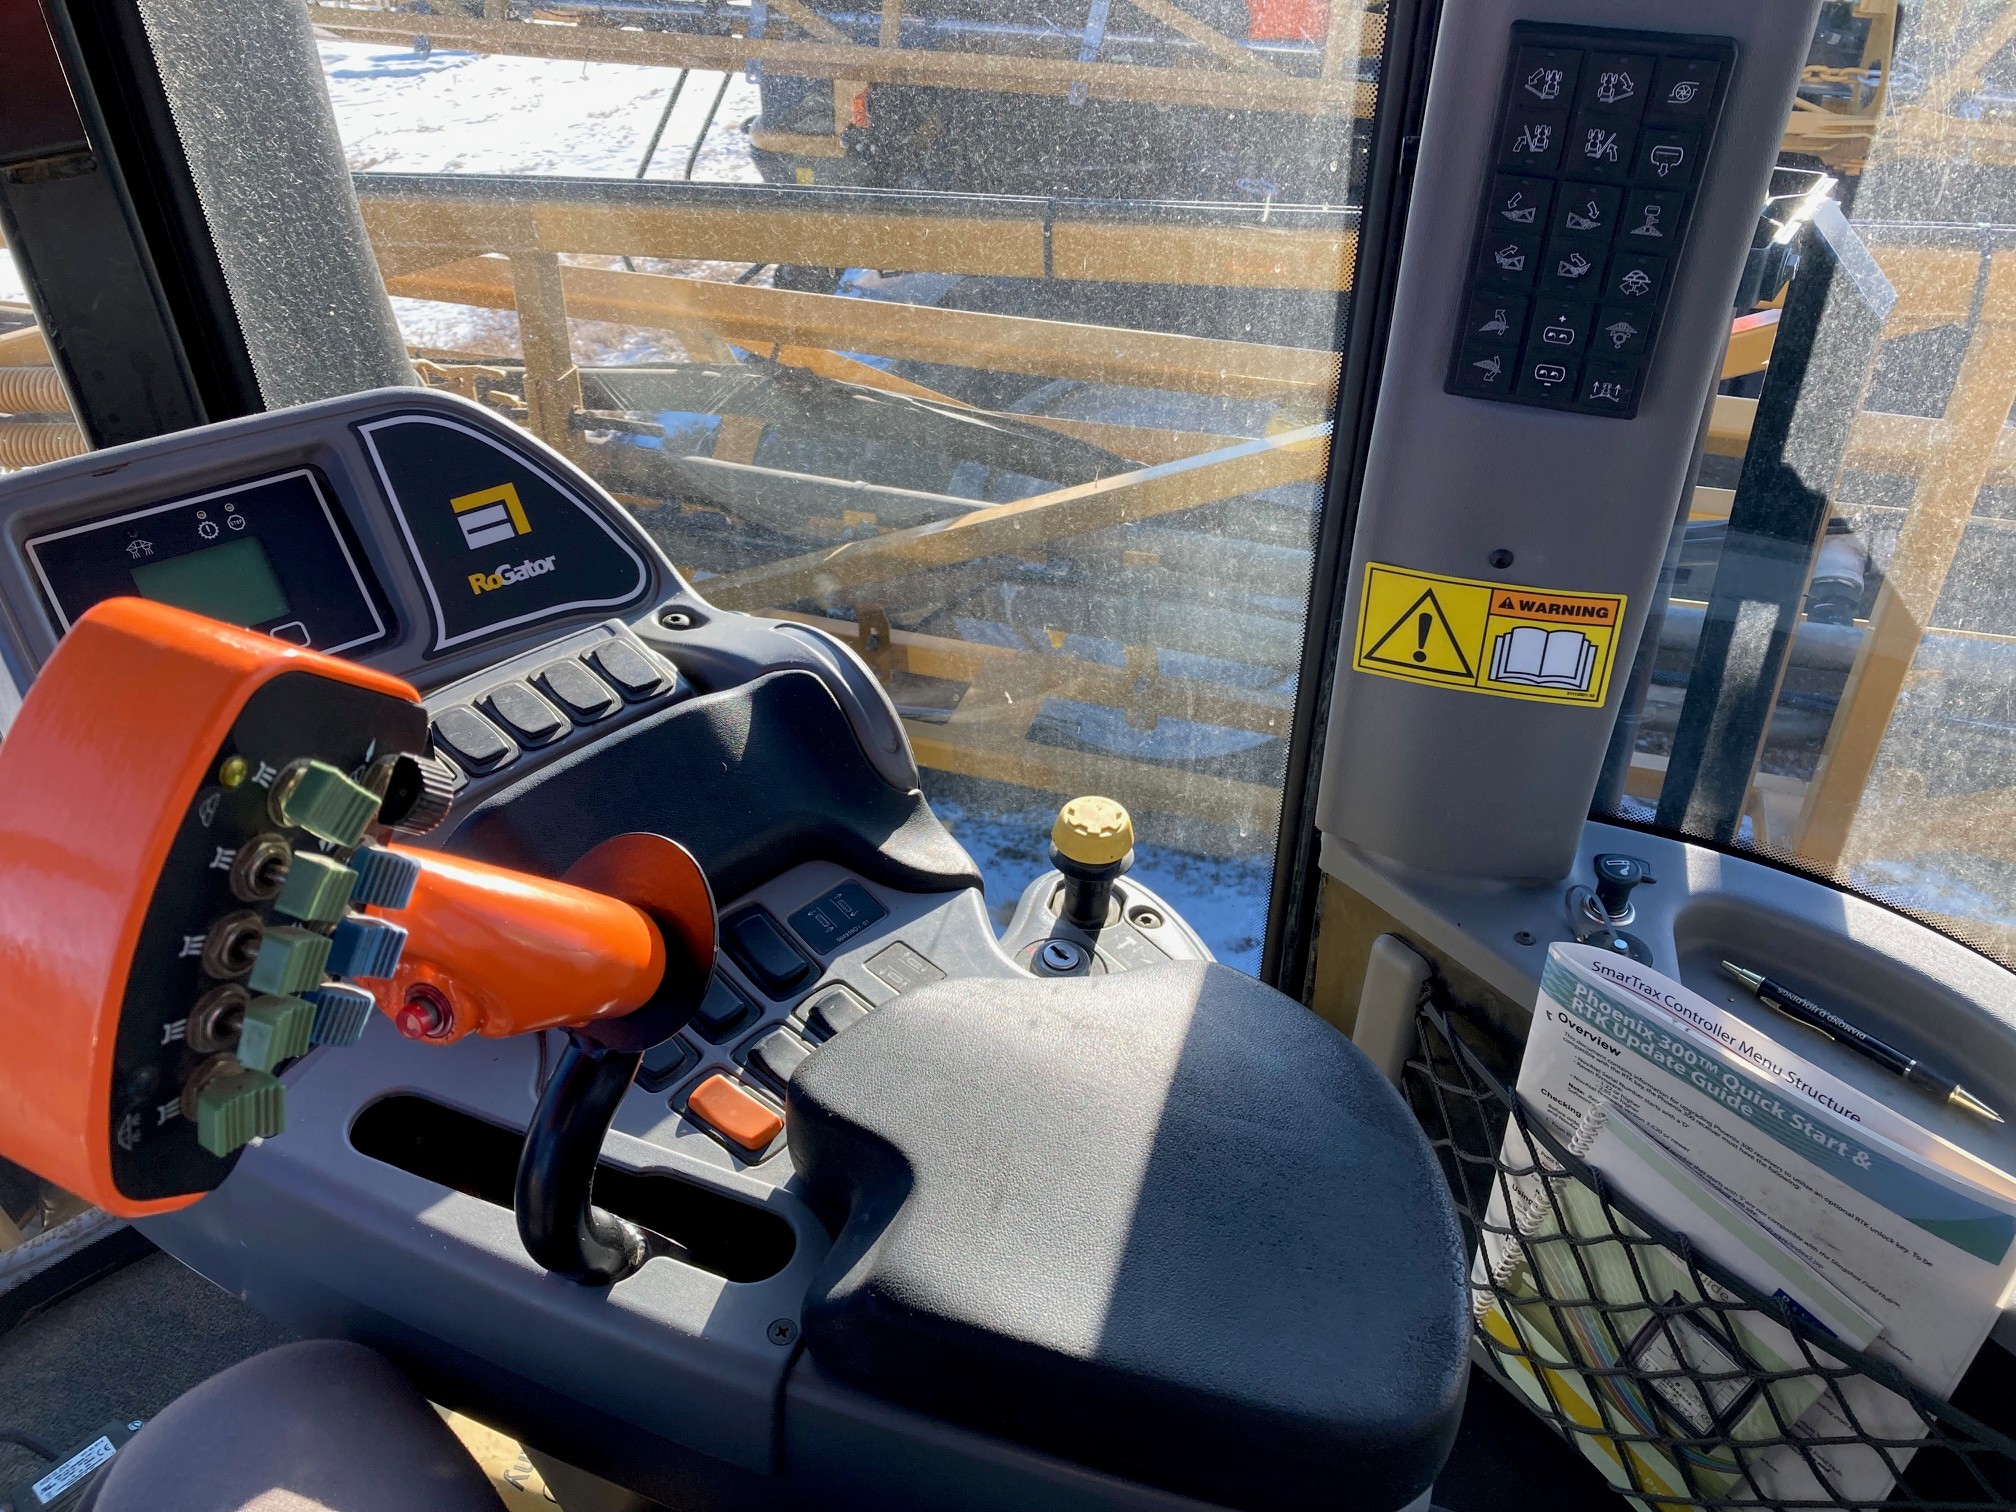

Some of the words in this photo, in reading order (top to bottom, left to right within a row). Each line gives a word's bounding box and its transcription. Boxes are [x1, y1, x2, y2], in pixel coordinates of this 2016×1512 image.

[467, 555, 556, 595] RoGator
[1519, 600, 1609, 619] WARNING
[1776, 987, 1819, 1014] HOLDINGS
[1558, 1012, 1622, 1057] Overview
[1591, 961, 1661, 1000] SmarTrax
[1664, 994, 1737, 1045] Controller
[1738, 1039, 1784, 1077] Menu
[1785, 1071, 1862, 1123] Structure
[1826, 1011, 1867, 1041] DIAMOND
[1571, 996, 1609, 1030] RTK
[1613, 1023, 1687, 1075] Update
[1689, 1072, 1754, 1118] Guide
[1574, 981, 1657, 1042] Phoenix
[1722, 1072, 1787, 1121] Quick
[1788, 1110, 1850, 1158] Start
[1852, 1150, 1872, 1171] &
[1540, 1088, 1581, 1118] Checking
[1618, 1081, 1643, 1099] Number
[1661, 1109, 1675, 1120] with
[1621, 1072, 1633, 1082] RTK
[1645, 1088, 1656, 1096] the
[1657, 1094, 1681, 1112] Phoenix
[1682, 1110, 1695, 1121] 300
[1695, 1119, 1720, 1137] receiver
[1721, 1136, 1738, 1149] must
[1738, 1146, 1755, 1159] have
[1755, 1158, 1767, 1167] the
[1607, 1059, 1632, 1076] contains
[1633, 1074, 1668, 1099] information
[1669, 1096, 1678, 1104] for
[1679, 1103, 1712, 1127] upgrading
[1713, 1124, 1739, 1143] Phoenix
[1740, 1141, 1753, 1152] 300
[1753, 1151, 1782, 1172] receivers
[1813, 1190, 1823, 1198] an
[1824, 1197, 1854, 1218] optional
[1854, 1216, 1869, 1228] RTK
[1869, 1226, 1893, 1243] unlock
[1912, 1251, 1921, 1260] To
[1922, 1257, 1933, 1267] be
[1723, 1185, 1737, 1196] with
[1803, 1240, 1818, 1252] with
[1818, 1251, 1830, 1260] the
[1830, 1258, 1861, 1281] Slingshot
[1861, 1280, 1878, 1293] Field
